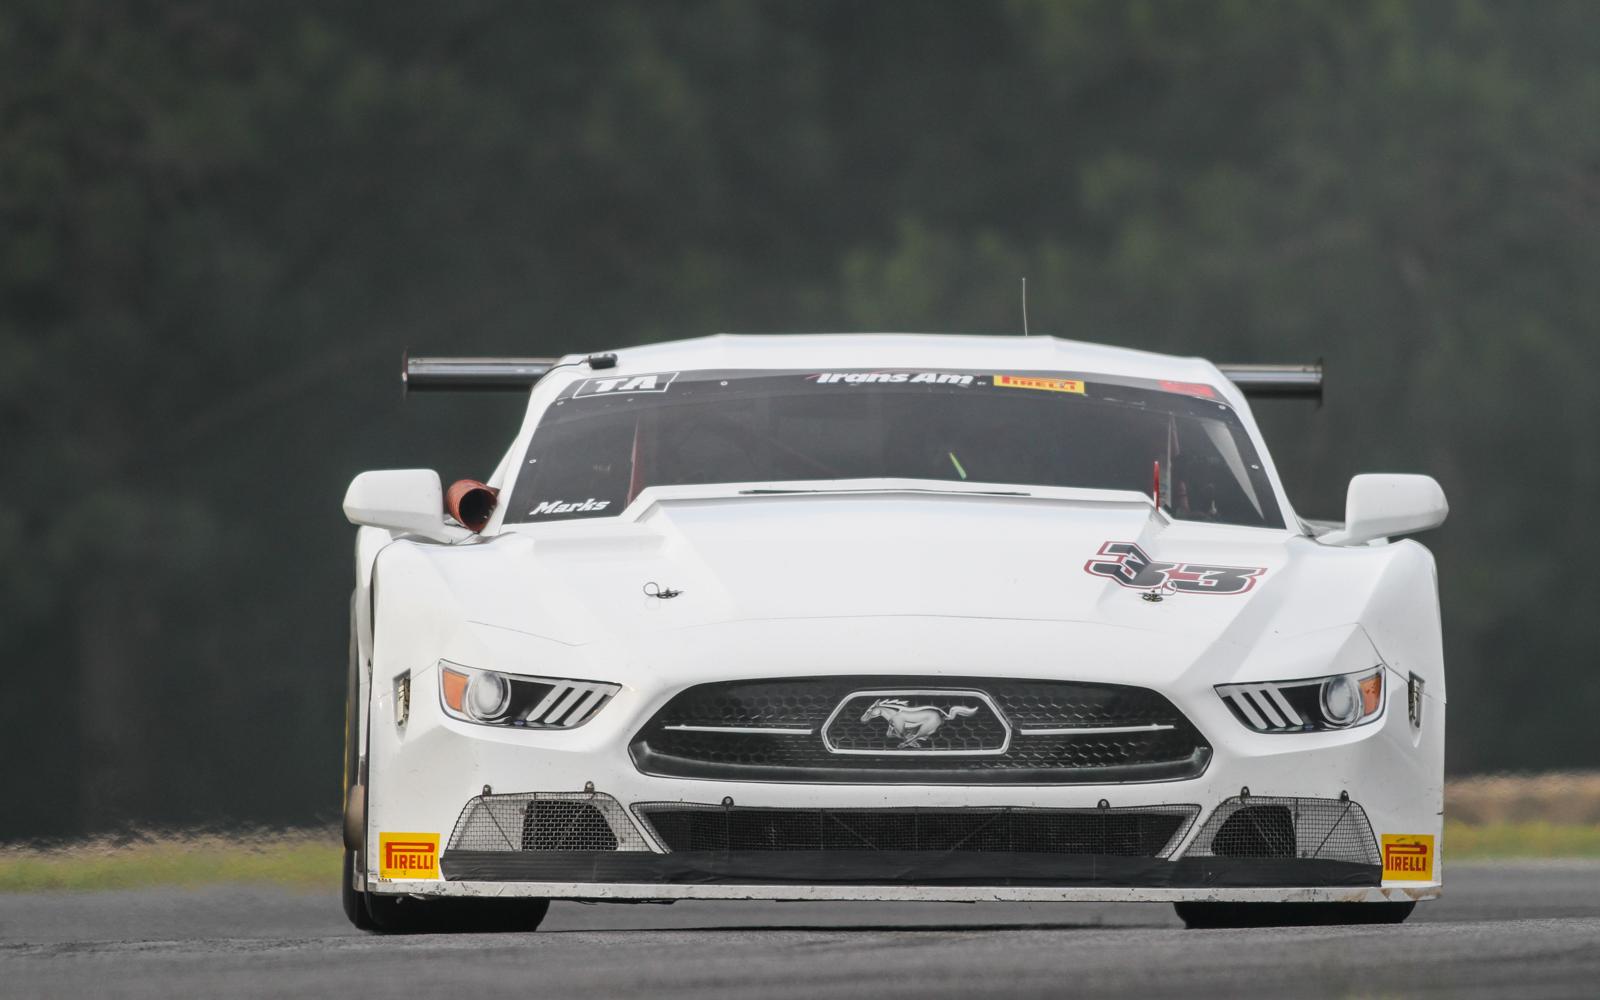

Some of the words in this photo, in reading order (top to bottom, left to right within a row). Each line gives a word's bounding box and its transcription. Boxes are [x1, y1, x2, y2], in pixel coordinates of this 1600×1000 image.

[595, 375, 658, 393] TA
[909, 373, 974, 385] Am
[529, 498, 611, 515] Marks
[1083, 541, 1268, 595] 33
[385, 842, 435, 870] PIRELLI
[1385, 844, 1427, 871] PIRELLI
